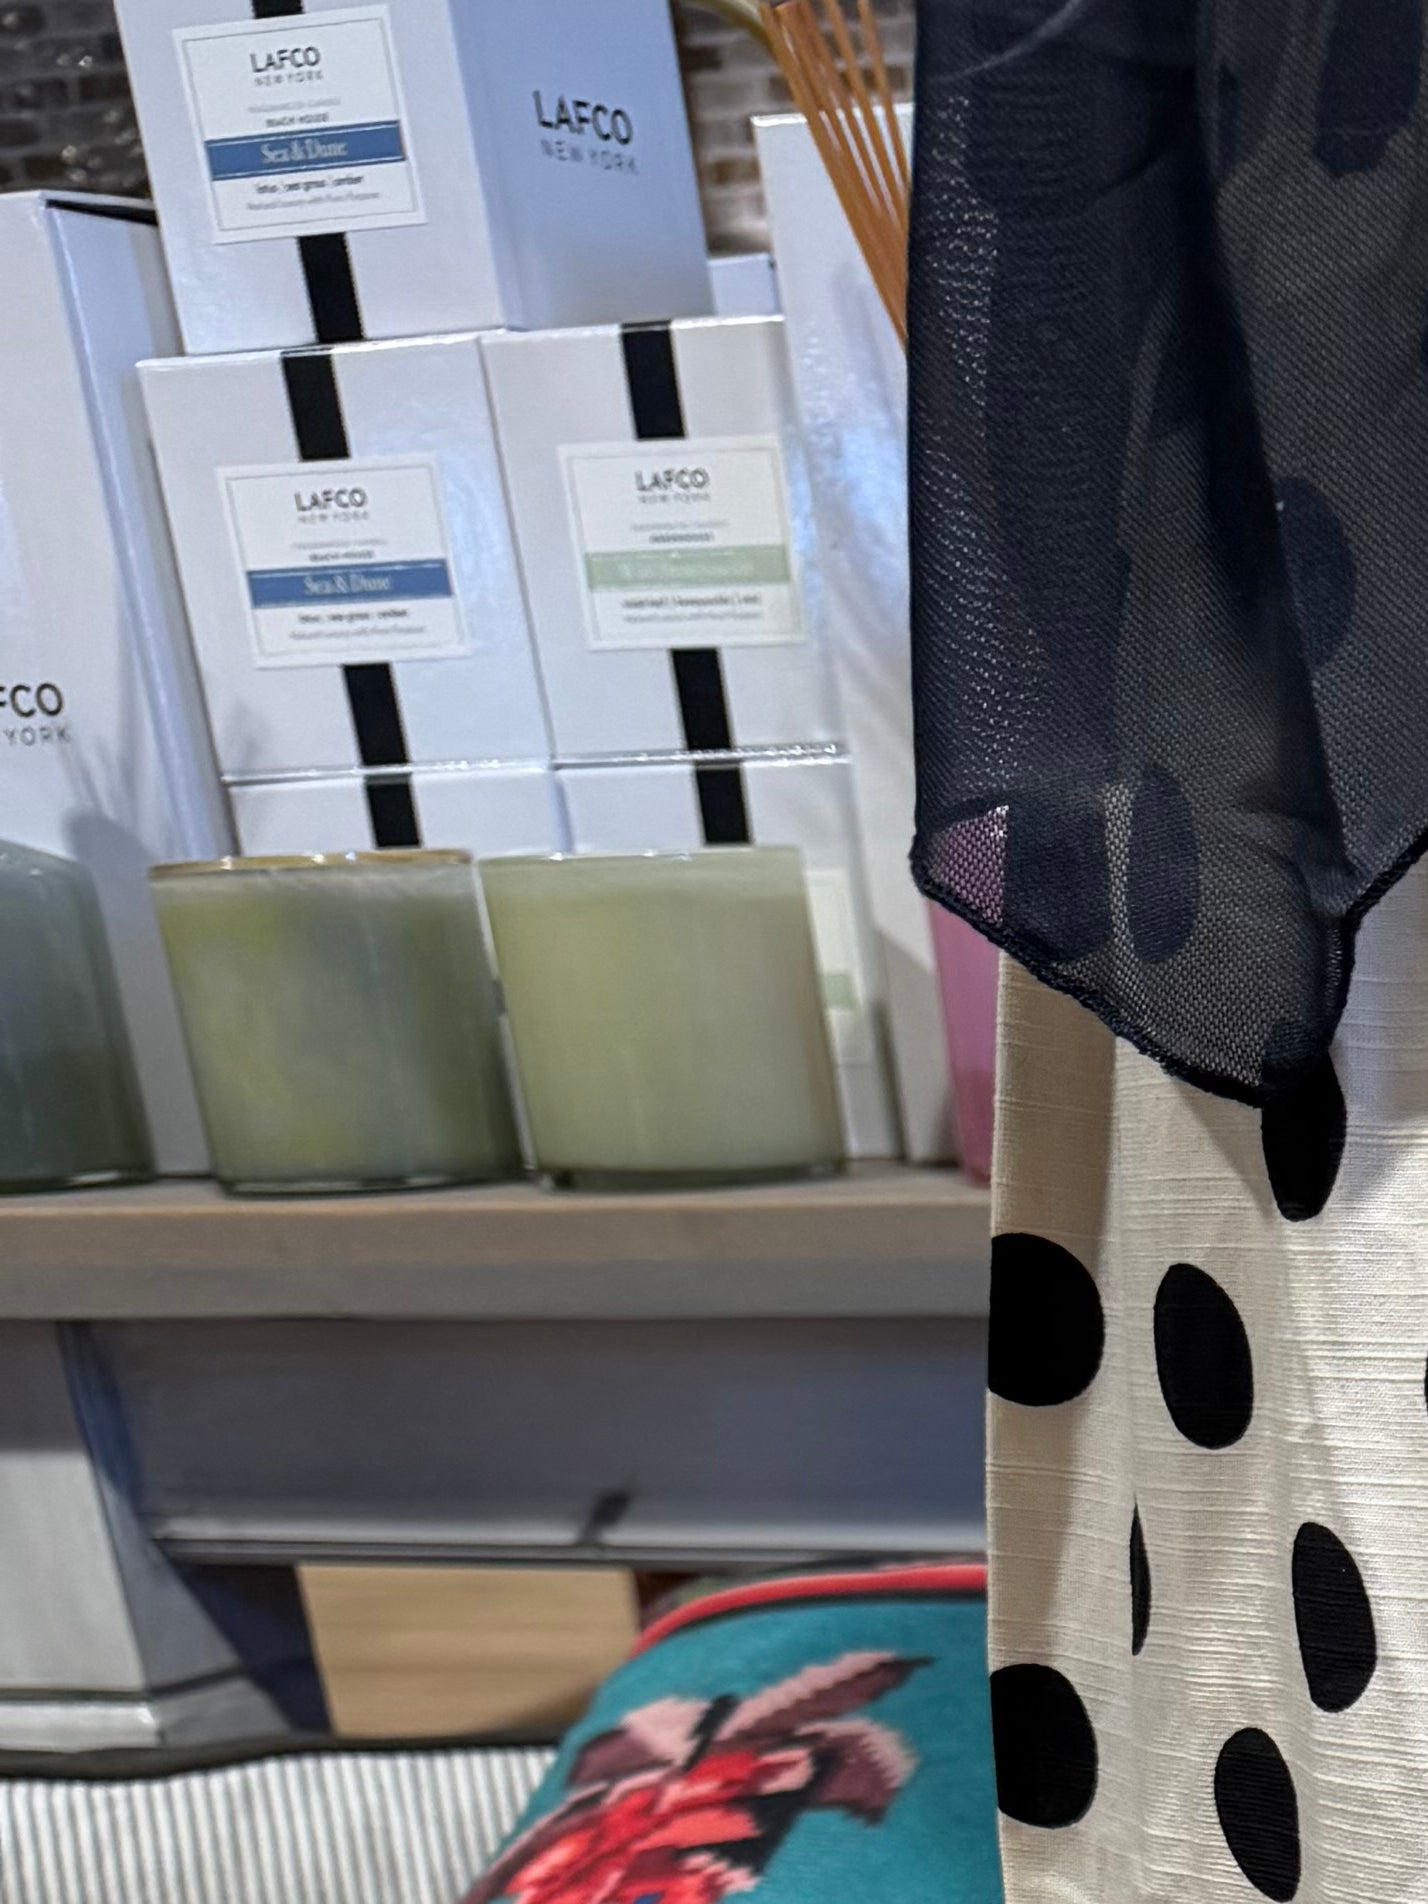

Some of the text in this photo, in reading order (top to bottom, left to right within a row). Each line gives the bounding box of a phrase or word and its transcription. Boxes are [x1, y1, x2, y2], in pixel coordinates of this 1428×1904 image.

[250, 46, 321, 73] LAFCO
[254, 74, 282, 87] NEW
[532, 90, 633, 146] LAFCO
[540, 138, 639, 175] NEW YORK
[634, 468, 710, 492] LAFCO
[294, 488, 368, 512] LAFCO
